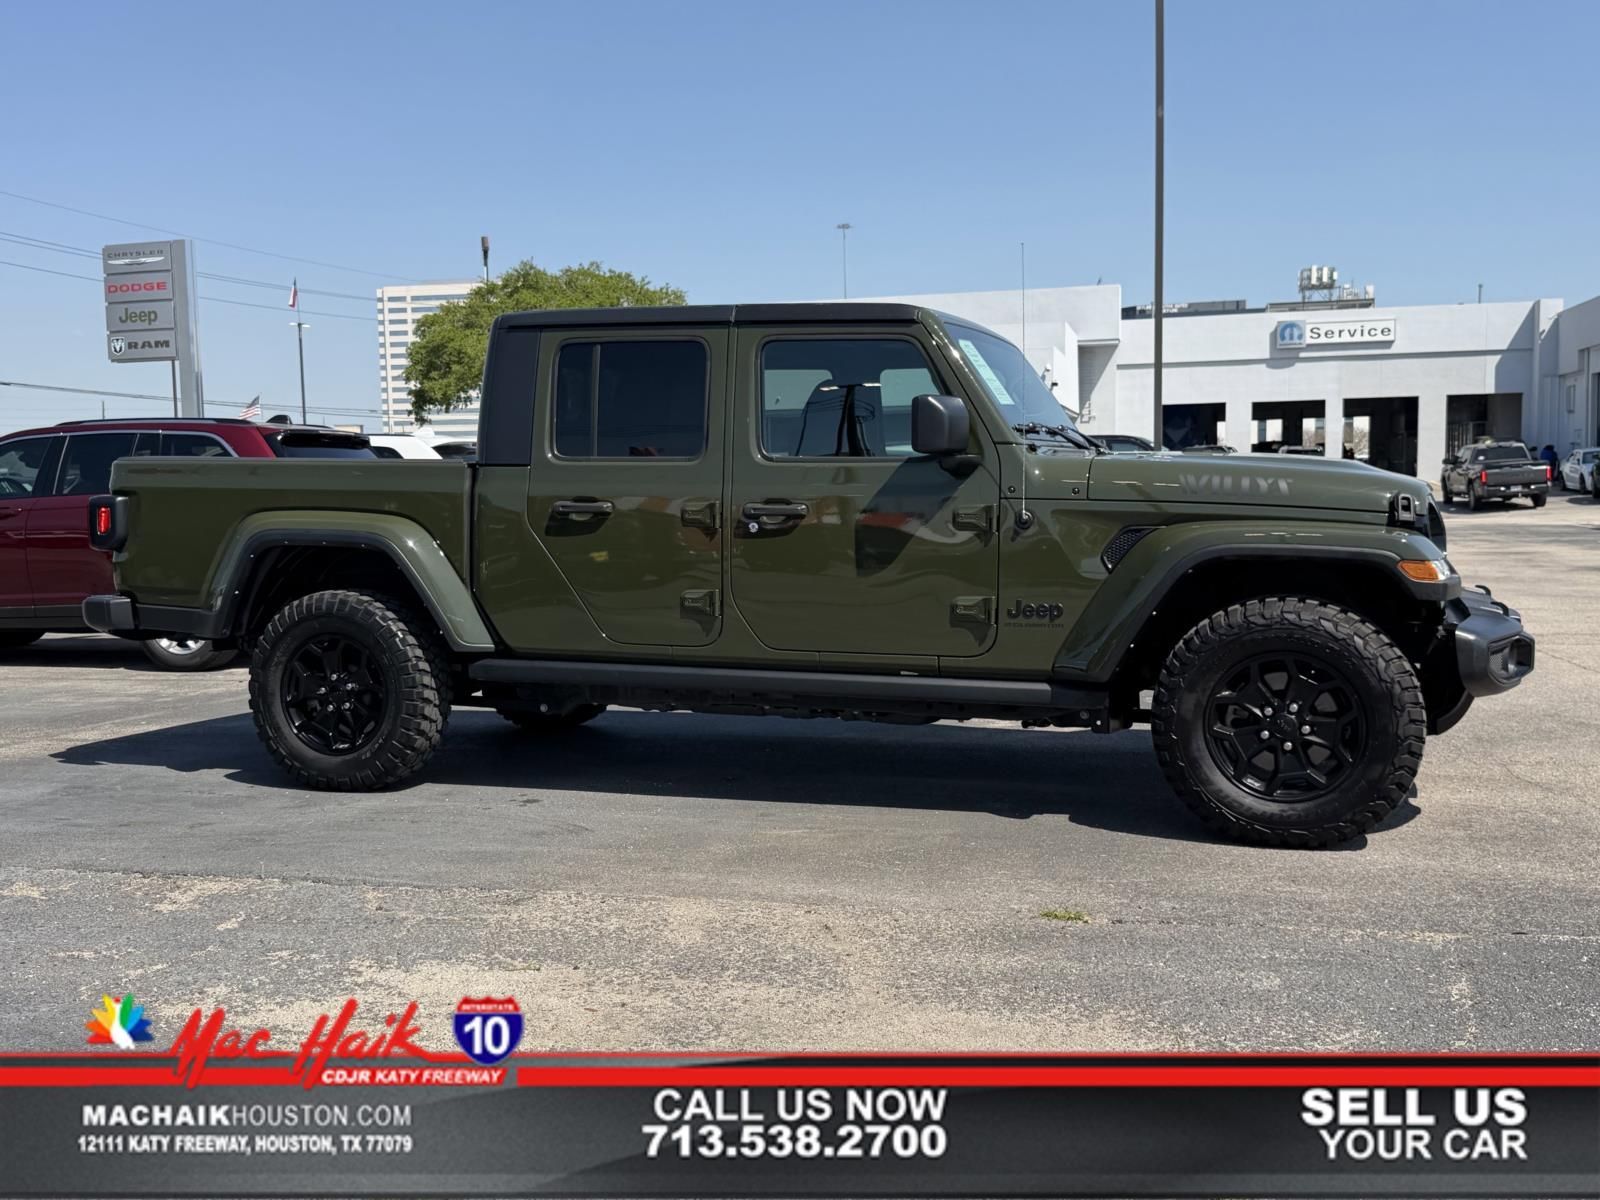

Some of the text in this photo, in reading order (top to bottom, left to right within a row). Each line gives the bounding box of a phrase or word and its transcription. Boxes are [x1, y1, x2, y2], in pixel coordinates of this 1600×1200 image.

[107, 249, 164, 259] CHRYSLER
[107, 282, 168, 294] DODGE
[118, 307, 158, 326] Jeep
[1309, 325, 1392, 339] Service
[127, 340, 170, 350] RAM
[1007, 599, 1064, 623] Jeep
